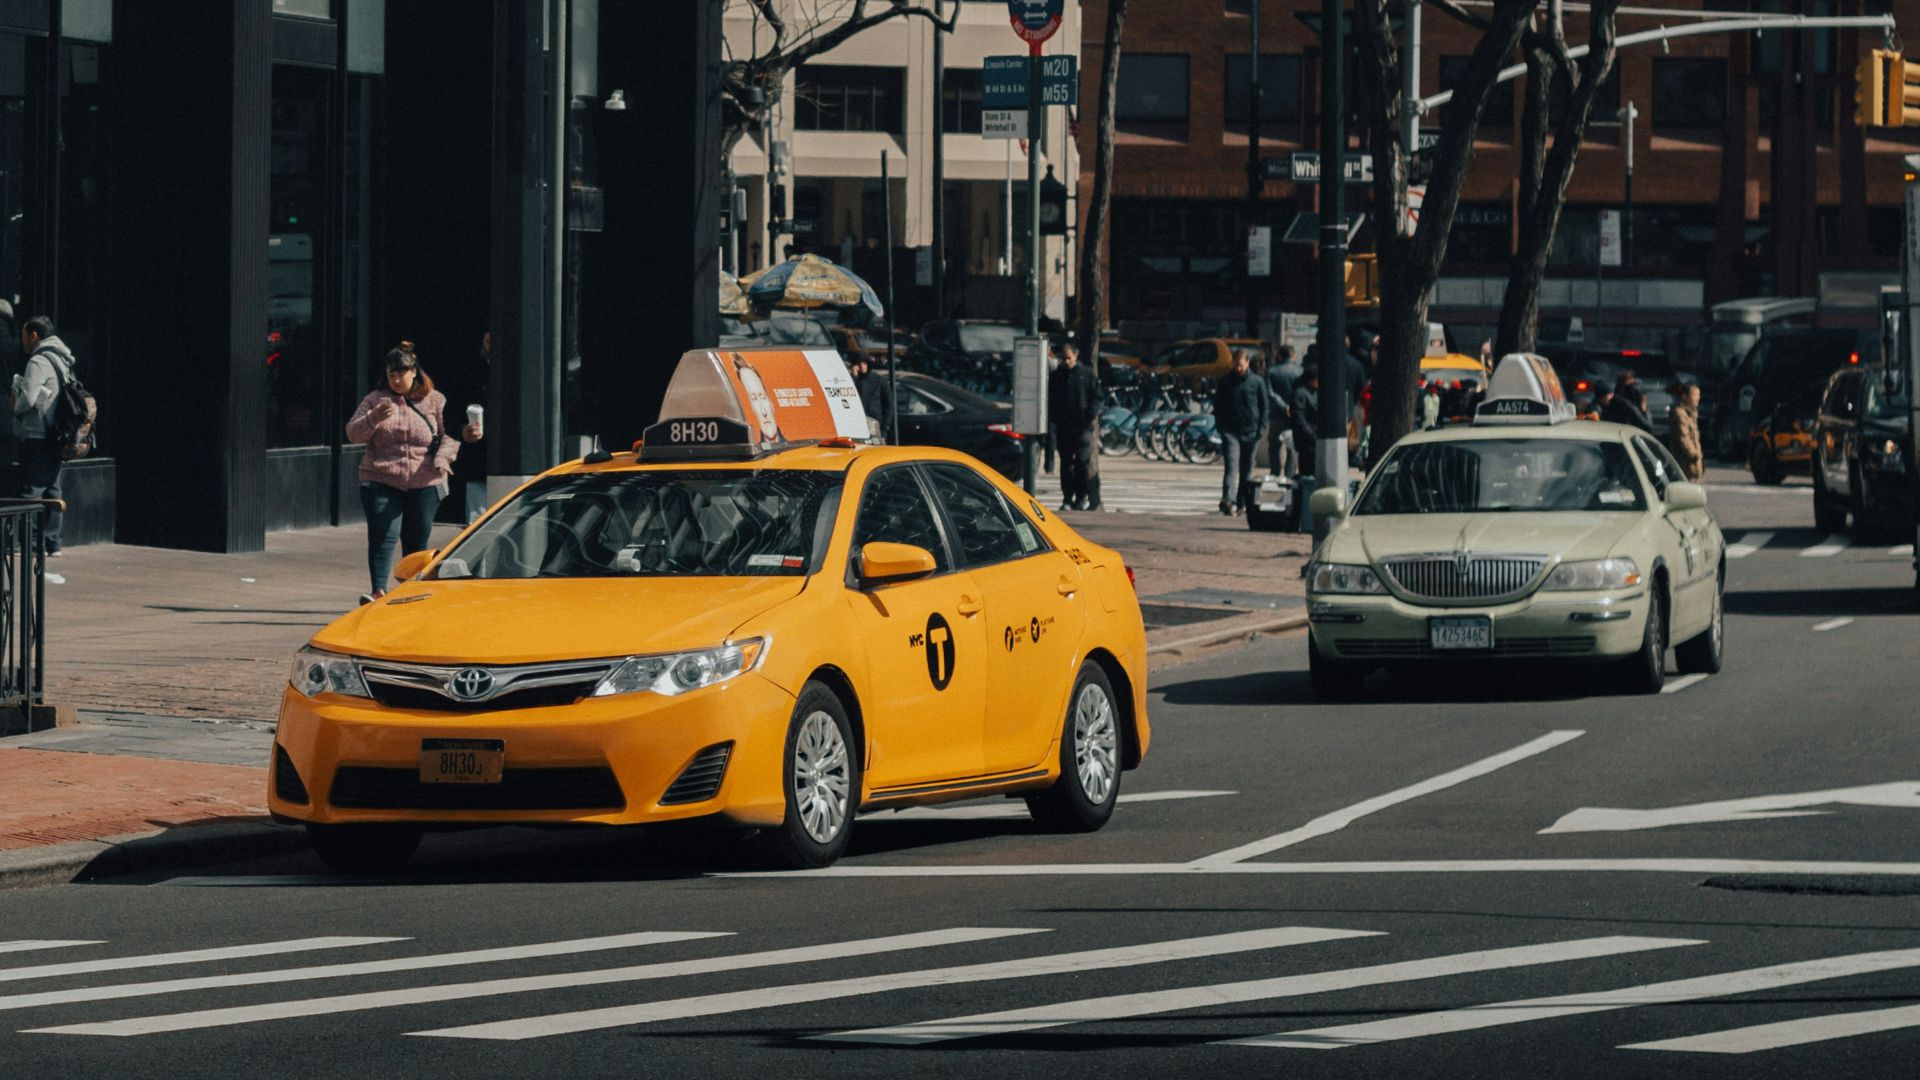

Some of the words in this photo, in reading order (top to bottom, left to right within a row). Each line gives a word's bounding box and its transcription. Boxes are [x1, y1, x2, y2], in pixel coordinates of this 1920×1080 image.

[1013, 20, 1024, 34] NO
[1024, 18, 1057, 40] STANDING
[1006, 60, 1024, 69] Center
[1043, 58, 1069, 77] M20
[1043, 83, 1069, 102] M55
[985, 112, 999, 121] State
[1496, 401, 1529, 414] AA574
[670, 421, 719, 442] 8H30
[909, 633, 924, 648] NYC
